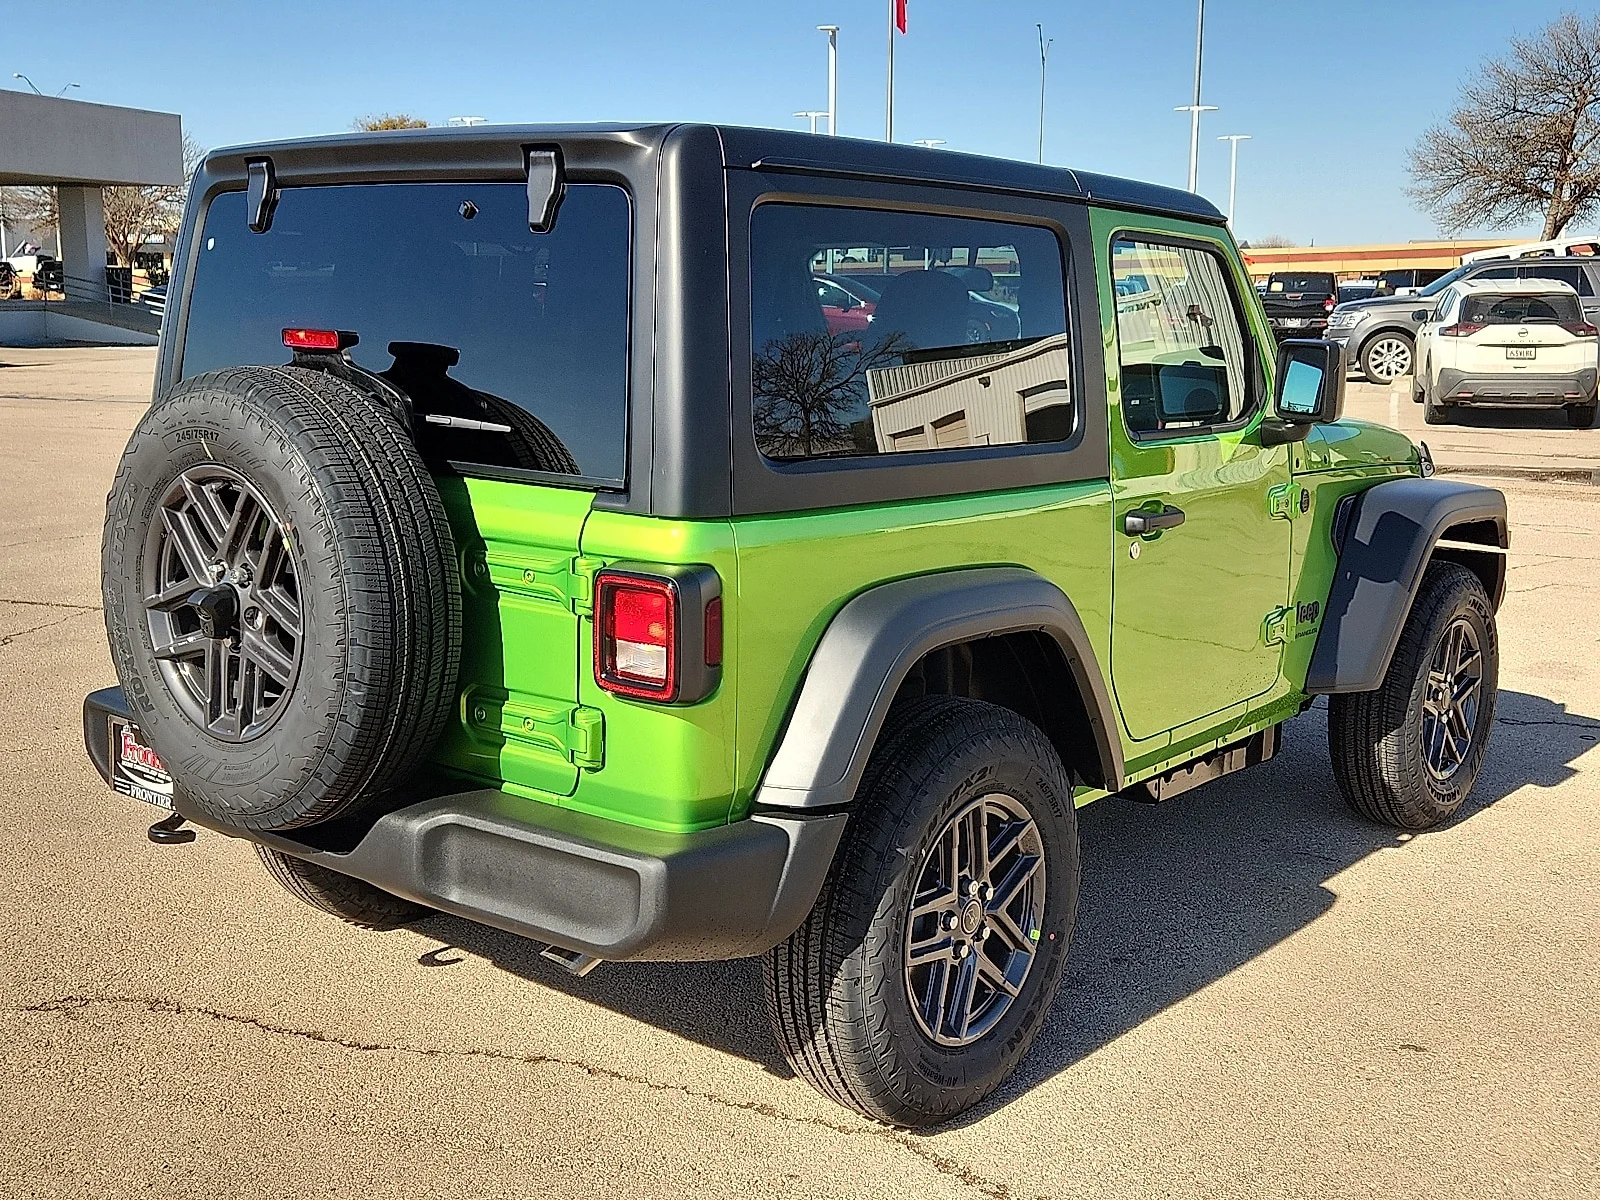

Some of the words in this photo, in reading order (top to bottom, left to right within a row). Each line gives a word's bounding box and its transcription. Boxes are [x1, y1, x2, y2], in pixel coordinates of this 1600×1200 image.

[175, 428, 220, 443] 245/75R17
[1296, 600, 1320, 625] Jeep
[1470, 598, 1495, 651] NEXEN
[131, 784, 172, 810] FRONTIER
[1035, 778, 1062, 818] 245/75R17
